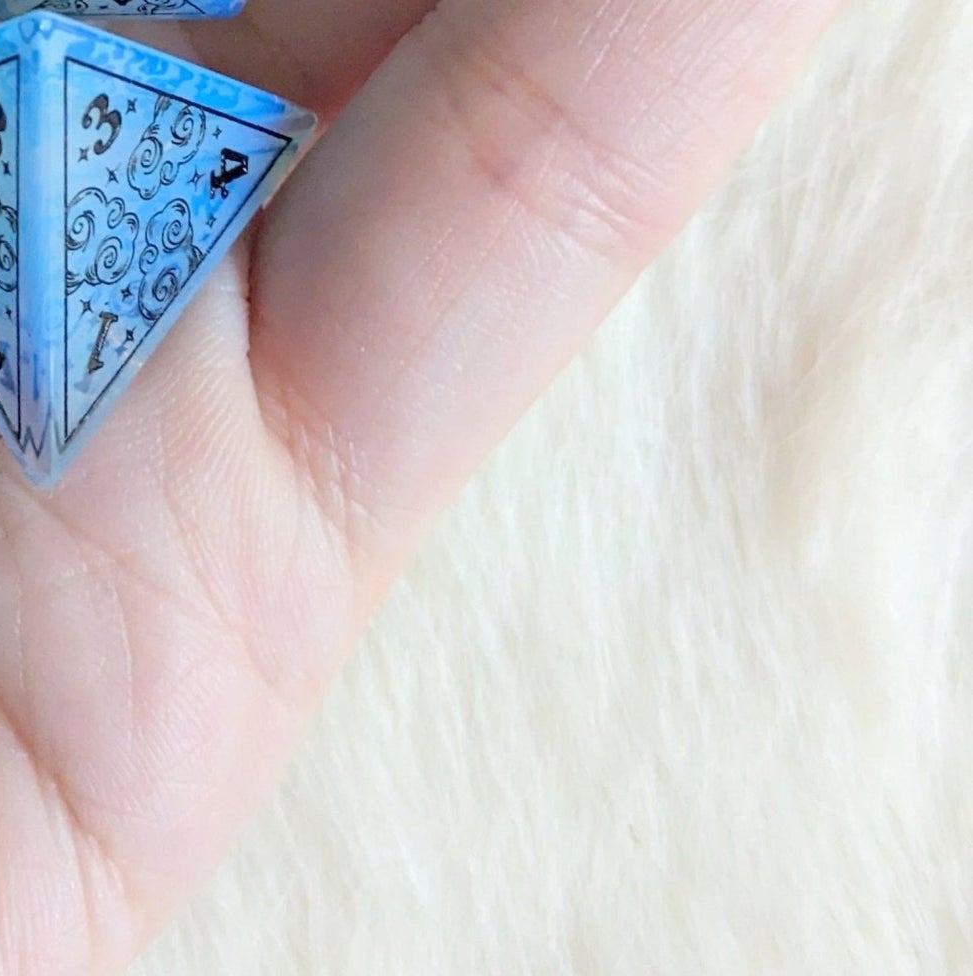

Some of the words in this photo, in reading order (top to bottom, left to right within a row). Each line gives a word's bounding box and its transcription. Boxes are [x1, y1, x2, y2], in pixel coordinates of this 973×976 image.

[81, 92, 122, 155] 3
[209, 146, 249, 200] 4
[87, 310, 119, 375] 1
